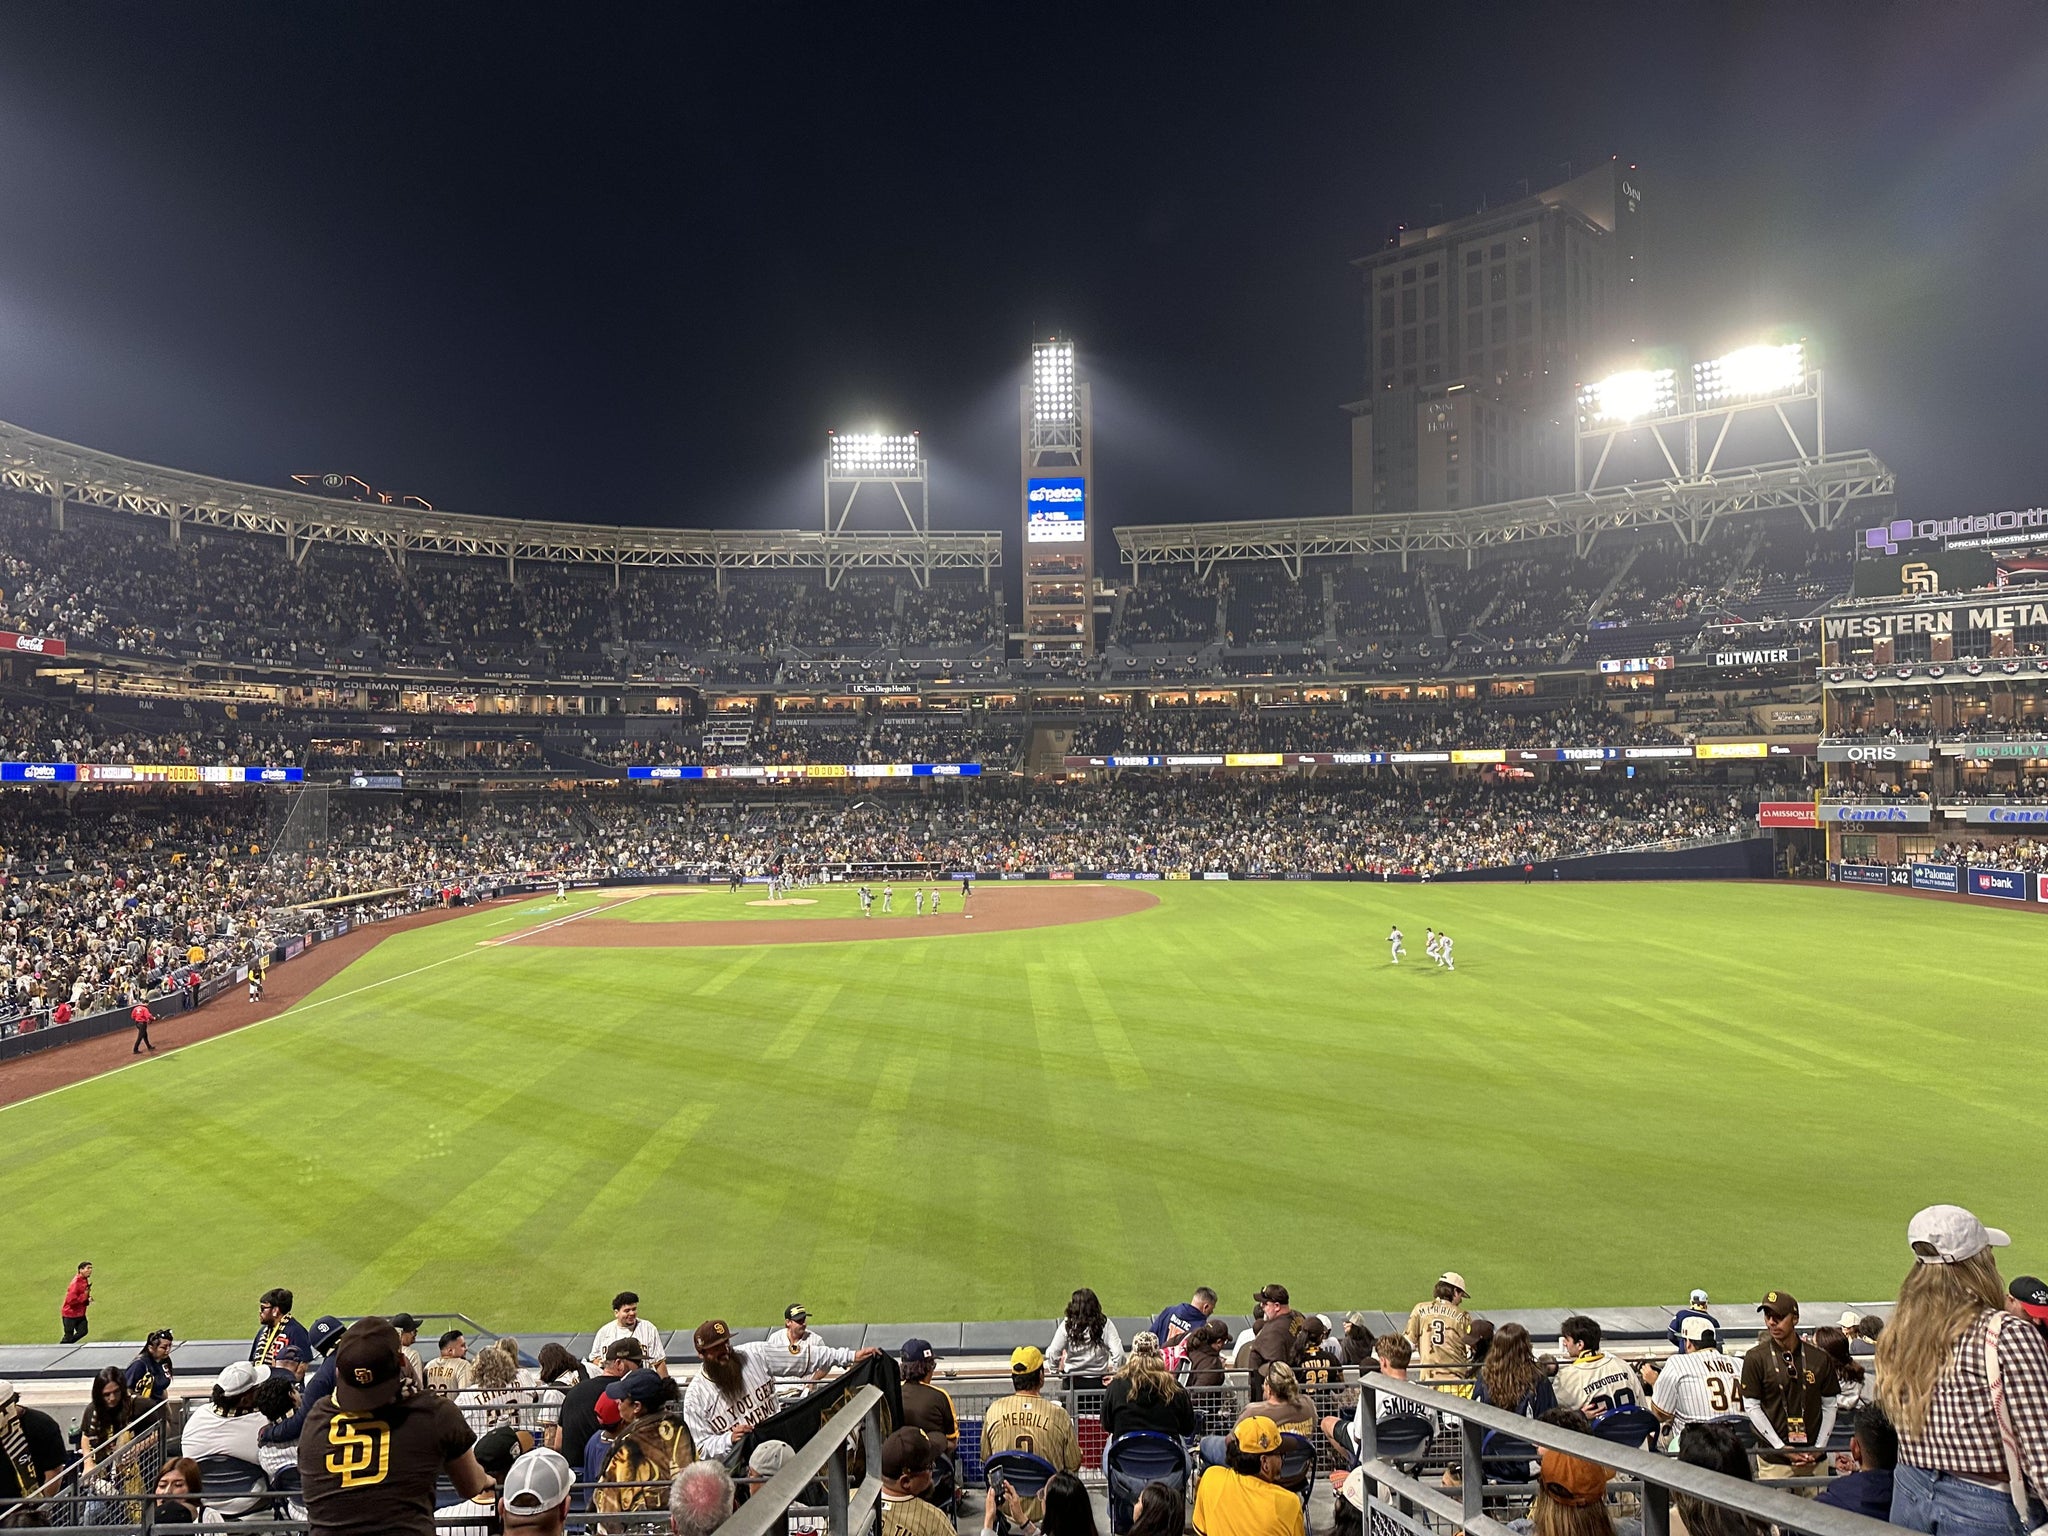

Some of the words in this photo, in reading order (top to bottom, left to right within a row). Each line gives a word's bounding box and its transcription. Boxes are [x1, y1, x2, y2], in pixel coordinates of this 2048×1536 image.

[1948, 540, 1980, 549] OFFICIAL
[1981, 533, 2029, 546] DIAGNOSTICS
[1825, 610, 1953, 639] WESTERN
[1968, 604, 2048, 630] META
[1715, 650, 1788, 666] CUTWATER
[343, 681, 400, 691] COLEMAN
[403, 684, 475, 693] BROADCAST
[853, 685, 863, 693] UC
[864, 685, 875, 693] San
[875, 685, 892, 694] Diego
[892, 685, 911, 693] Health
[1564, 749, 1604, 759] TIGERS
[1847, 746, 1897, 761] ORIS
[1975, 745, 1998, 757] BIG
[2000, 745, 2040, 757] BULLY
[1113, 757, 1149, 766] TIGERS
[1333, 754, 1371, 763] TIGERS
[1772, 810, 1804, 818] MISSION
[1841, 821, 1865, 833] 336
[1891, 871, 1909, 884] 342
[1924, 867, 1954, 881] Palomar
[1915, 878, 1934, 886] SPECIALTY
[1934, 879, 1955, 887] INSURANCE
[1980, 877, 1990, 887] us
[1991, 875, 2014, 889] bank
[1432, 1319, 1446, 1346] 3
[1704, 1360, 1735, 1374] KING
[354, 1367, 374, 1385] SD
[727, 1394, 754, 1421] YOU
[755, 1380, 775, 1402] GET
[1706, 1376, 1745, 1412] 34
[744, 1399, 775, 1427] MEMO
[1002, 1412, 1049, 1432] MERRILL
[325, 1412, 391, 1488] SD
